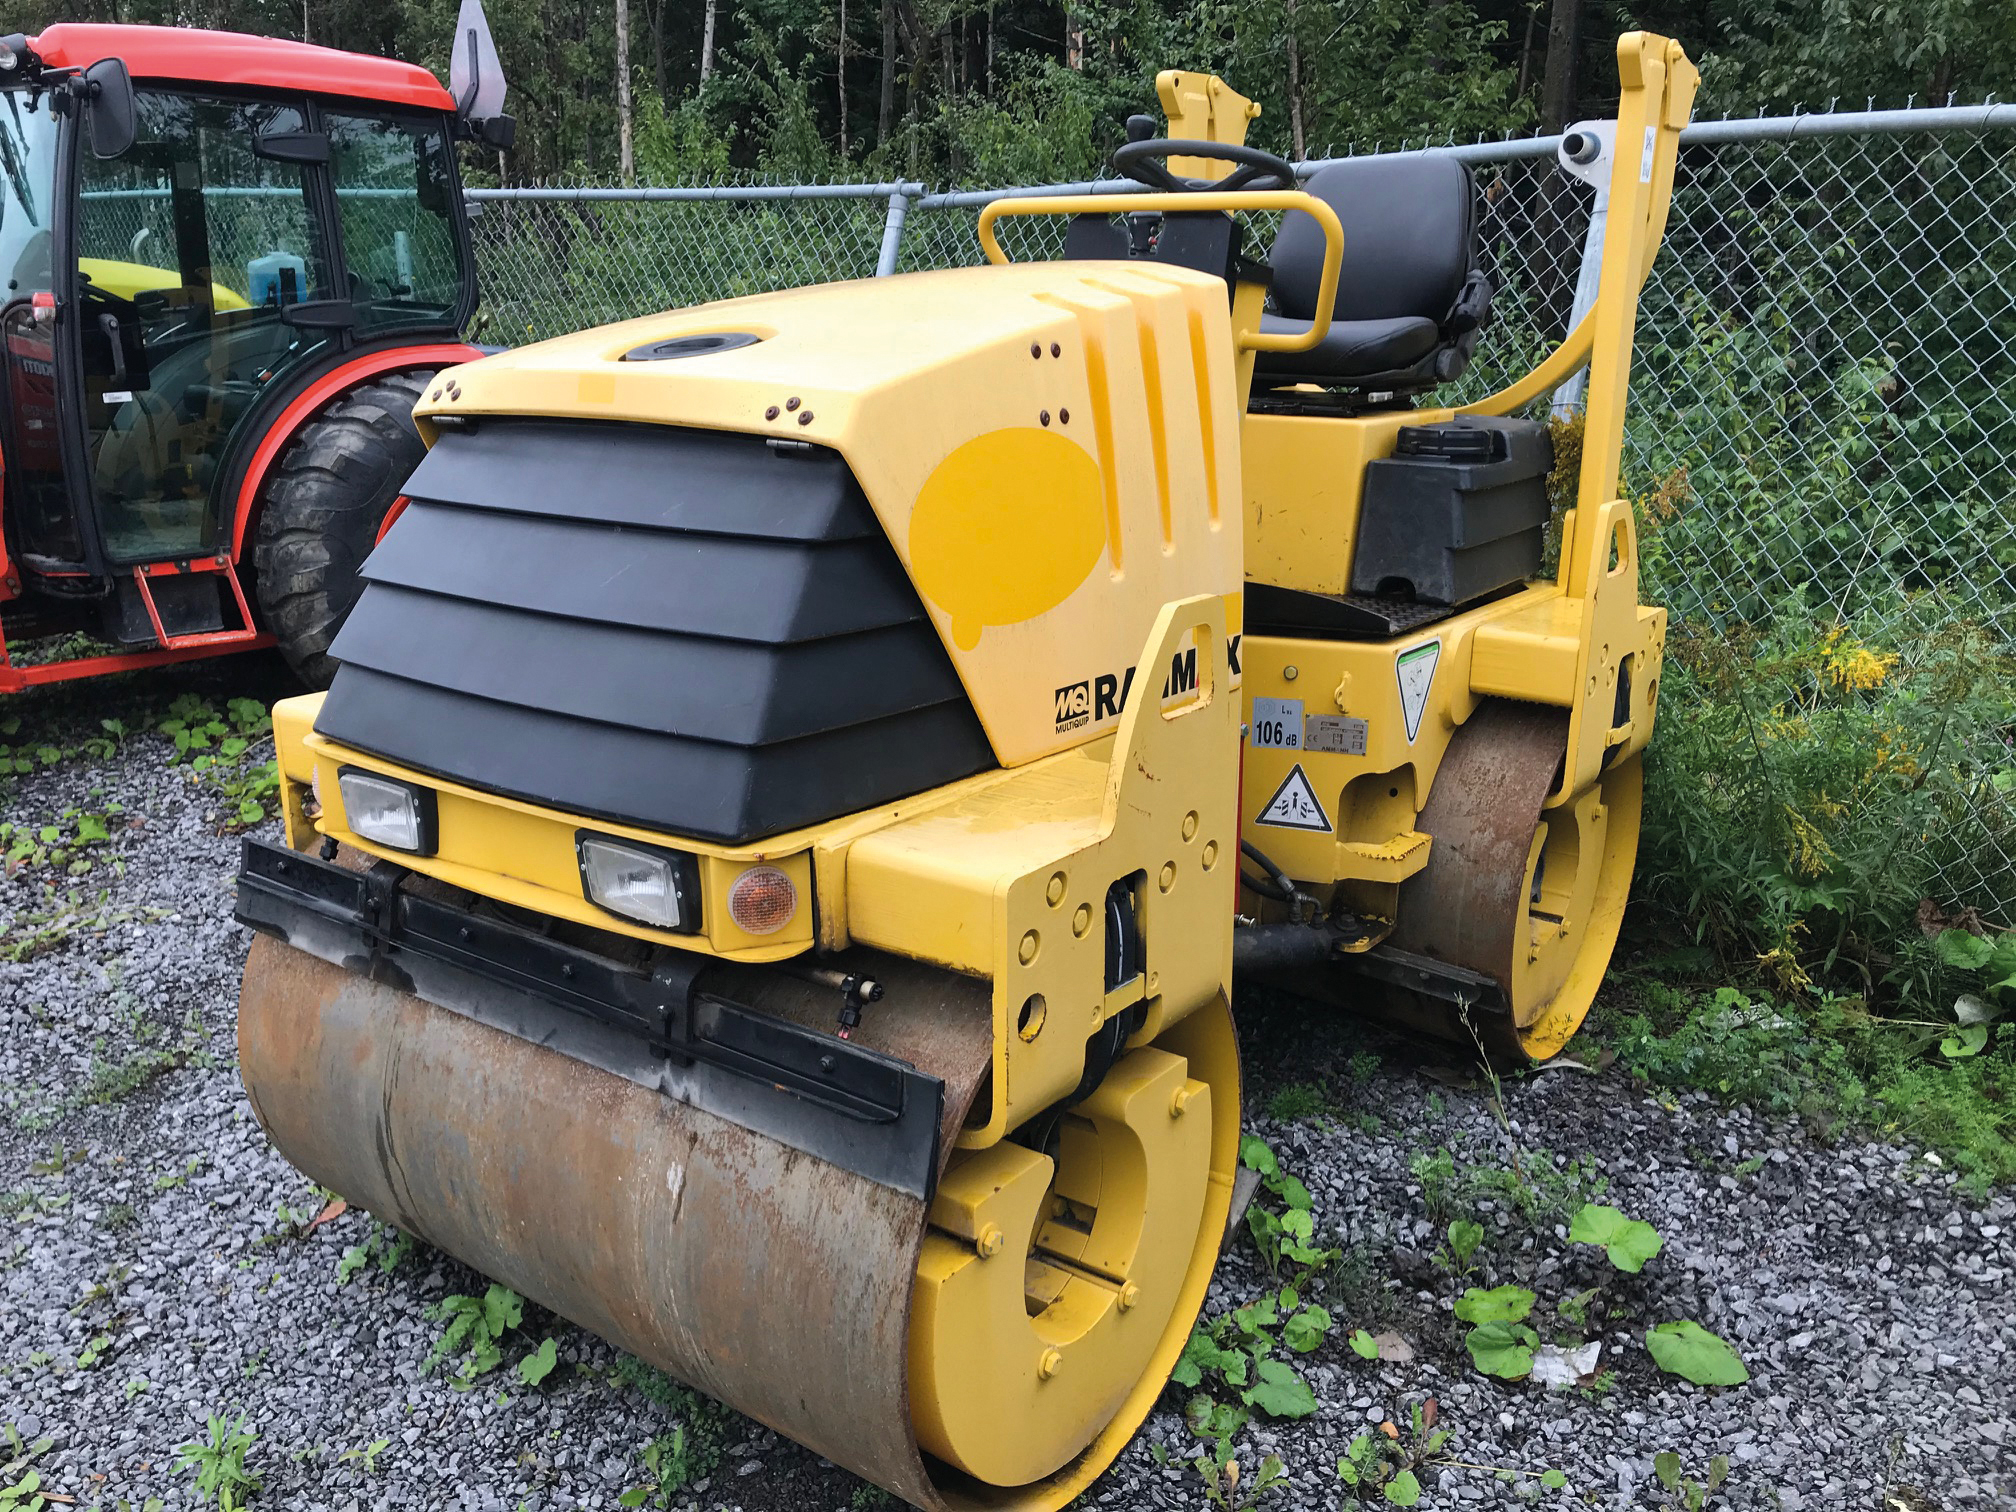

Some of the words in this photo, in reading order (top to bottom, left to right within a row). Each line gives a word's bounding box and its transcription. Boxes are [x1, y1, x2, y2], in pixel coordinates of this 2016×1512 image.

[1056, 685, 1089, 719] MQ
[1055, 715, 1090, 735] MULTIQUIP
[1256, 720, 1283, 745] 106
[1286, 734, 1297, 746] dB
